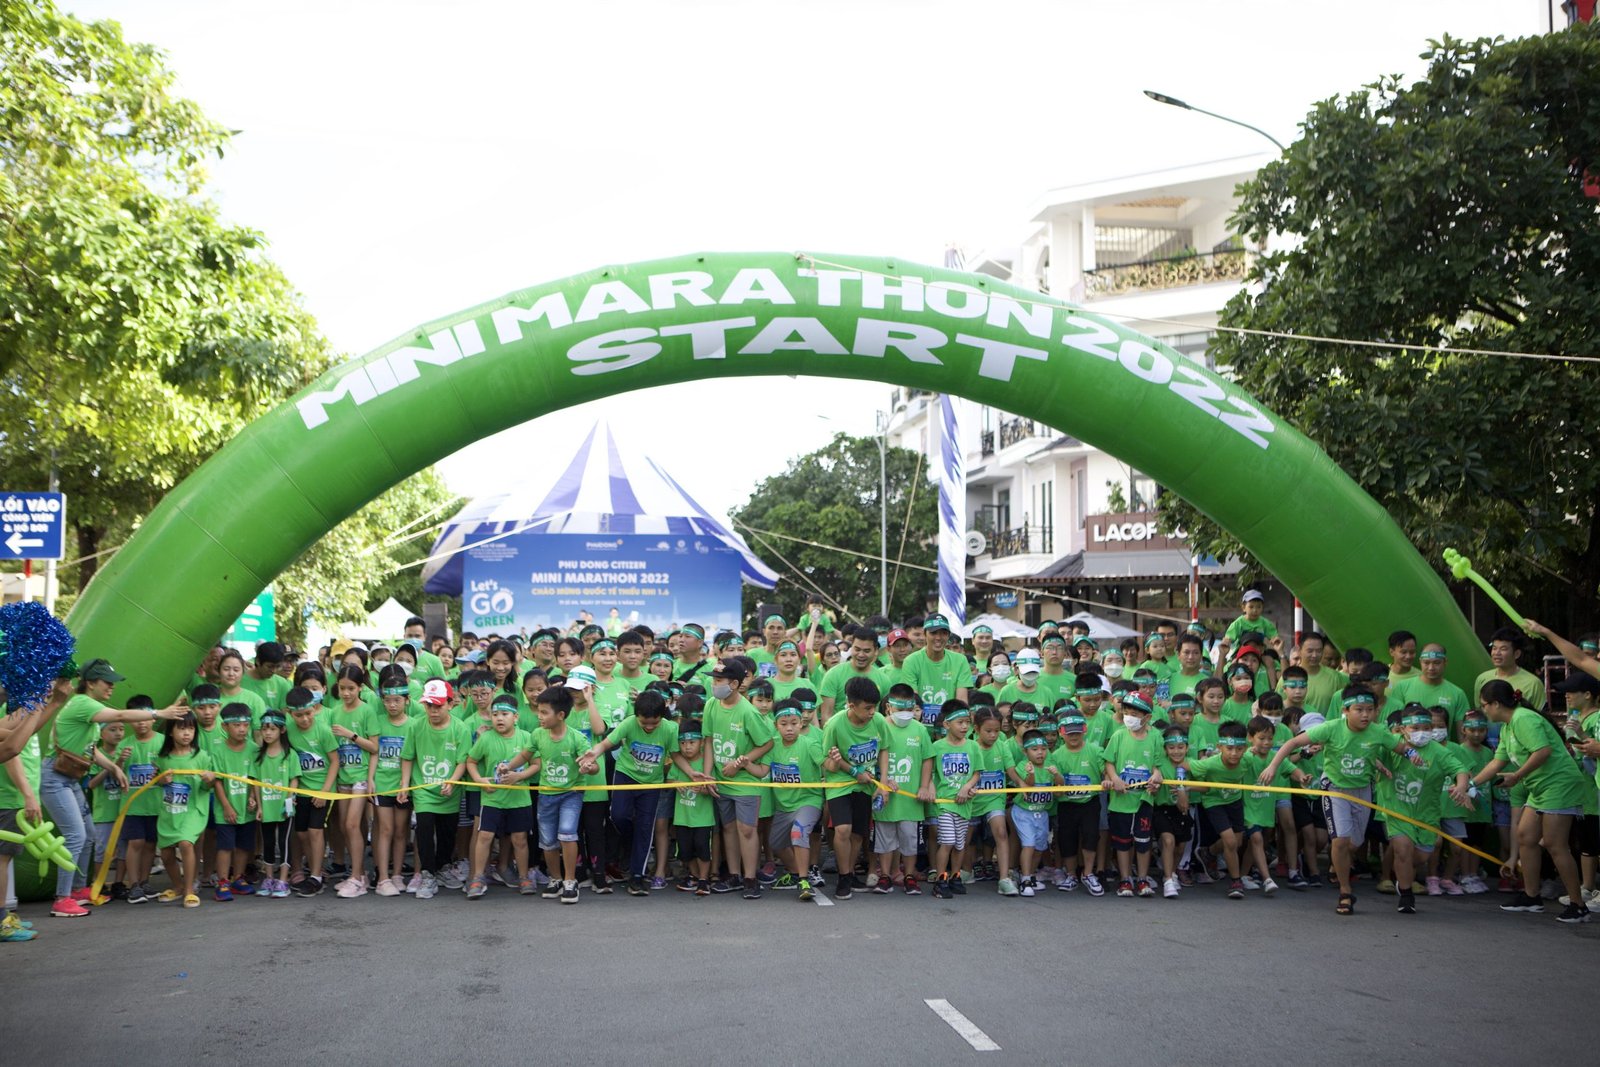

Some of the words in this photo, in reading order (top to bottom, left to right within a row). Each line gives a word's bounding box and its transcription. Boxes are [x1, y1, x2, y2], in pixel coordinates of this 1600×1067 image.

[566, 316, 1048, 382] START
[295, 320, 486, 429] MINI
[492, 268, 1053, 344] MARATHON
[1061, 316, 1274, 449] 2022
[26, 496, 60, 512] VÀO
[558, 560, 577, 570] PHU
[580, 560, 609, 570] DONG
[611, 560, 646, 570] CITIZEN
[470, 579, 498, 592] Let's
[531, 572, 562, 584] MINI
[565, 572, 637, 584] MARATHON
[640, 573, 670, 584] 2022
[470, 591, 514, 615] GO
[474, 615, 515, 628] GREEN
[713, 739, 736, 757] GO
[422, 760, 450, 778] GO
